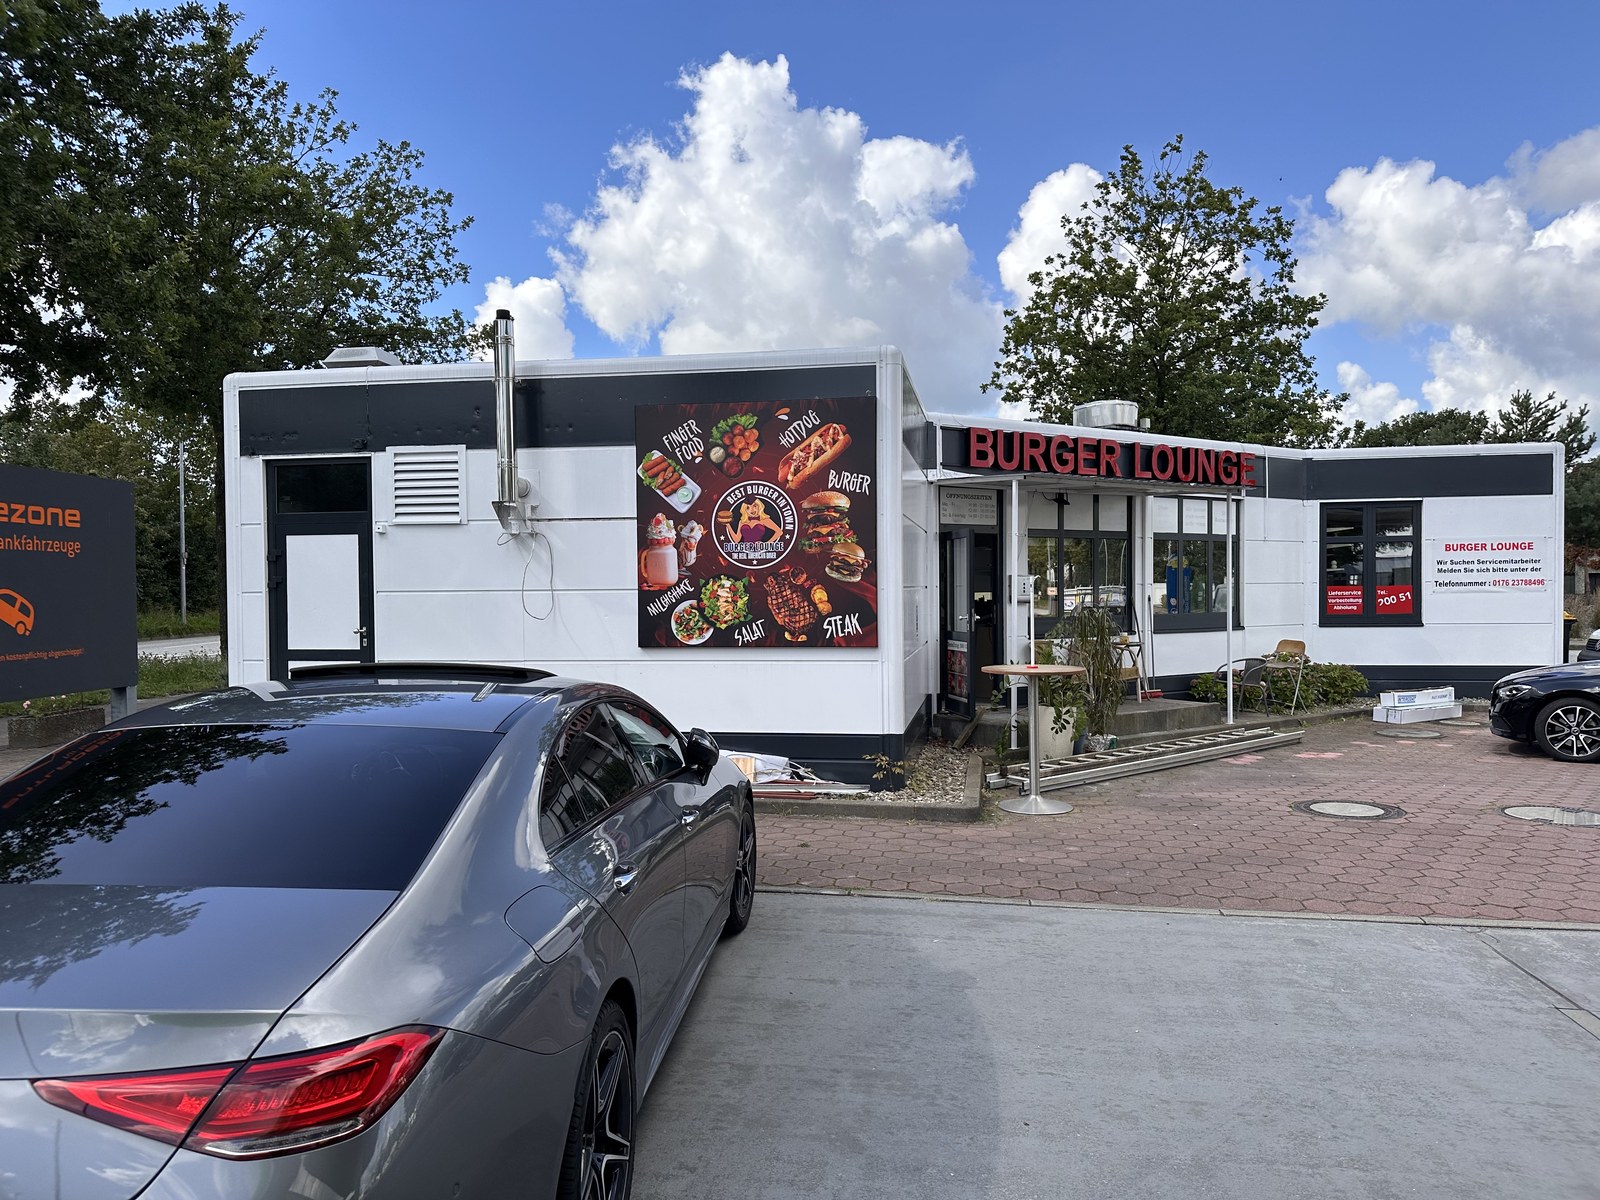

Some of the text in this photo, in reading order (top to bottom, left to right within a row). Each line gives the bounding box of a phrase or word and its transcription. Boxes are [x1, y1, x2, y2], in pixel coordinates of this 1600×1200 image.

[662, 419, 703, 452] FINGER
[778, 409, 821, 449] HOTDOG
[674, 437, 705, 465] FOOD
[969, 427, 1257, 486] BURGER LOUNGE
[828, 469, 871, 496] BURGER
[726, 485, 794, 531] BEST BURGER IN TOWN
[723, 541, 784, 553] BURGER LOUNGE
[1444, 542, 1534, 552] BURGER LOUNGE
[1398, 591, 1412, 602] 51
[1434, 580, 1487, 588] Telefonnummer
[1492, 579, 1510, 587] 0176
[1511, 578, 1546, 587] 23788496
[734, 618, 765, 647] SALAT
[822, 612, 864, 640] STEAK
